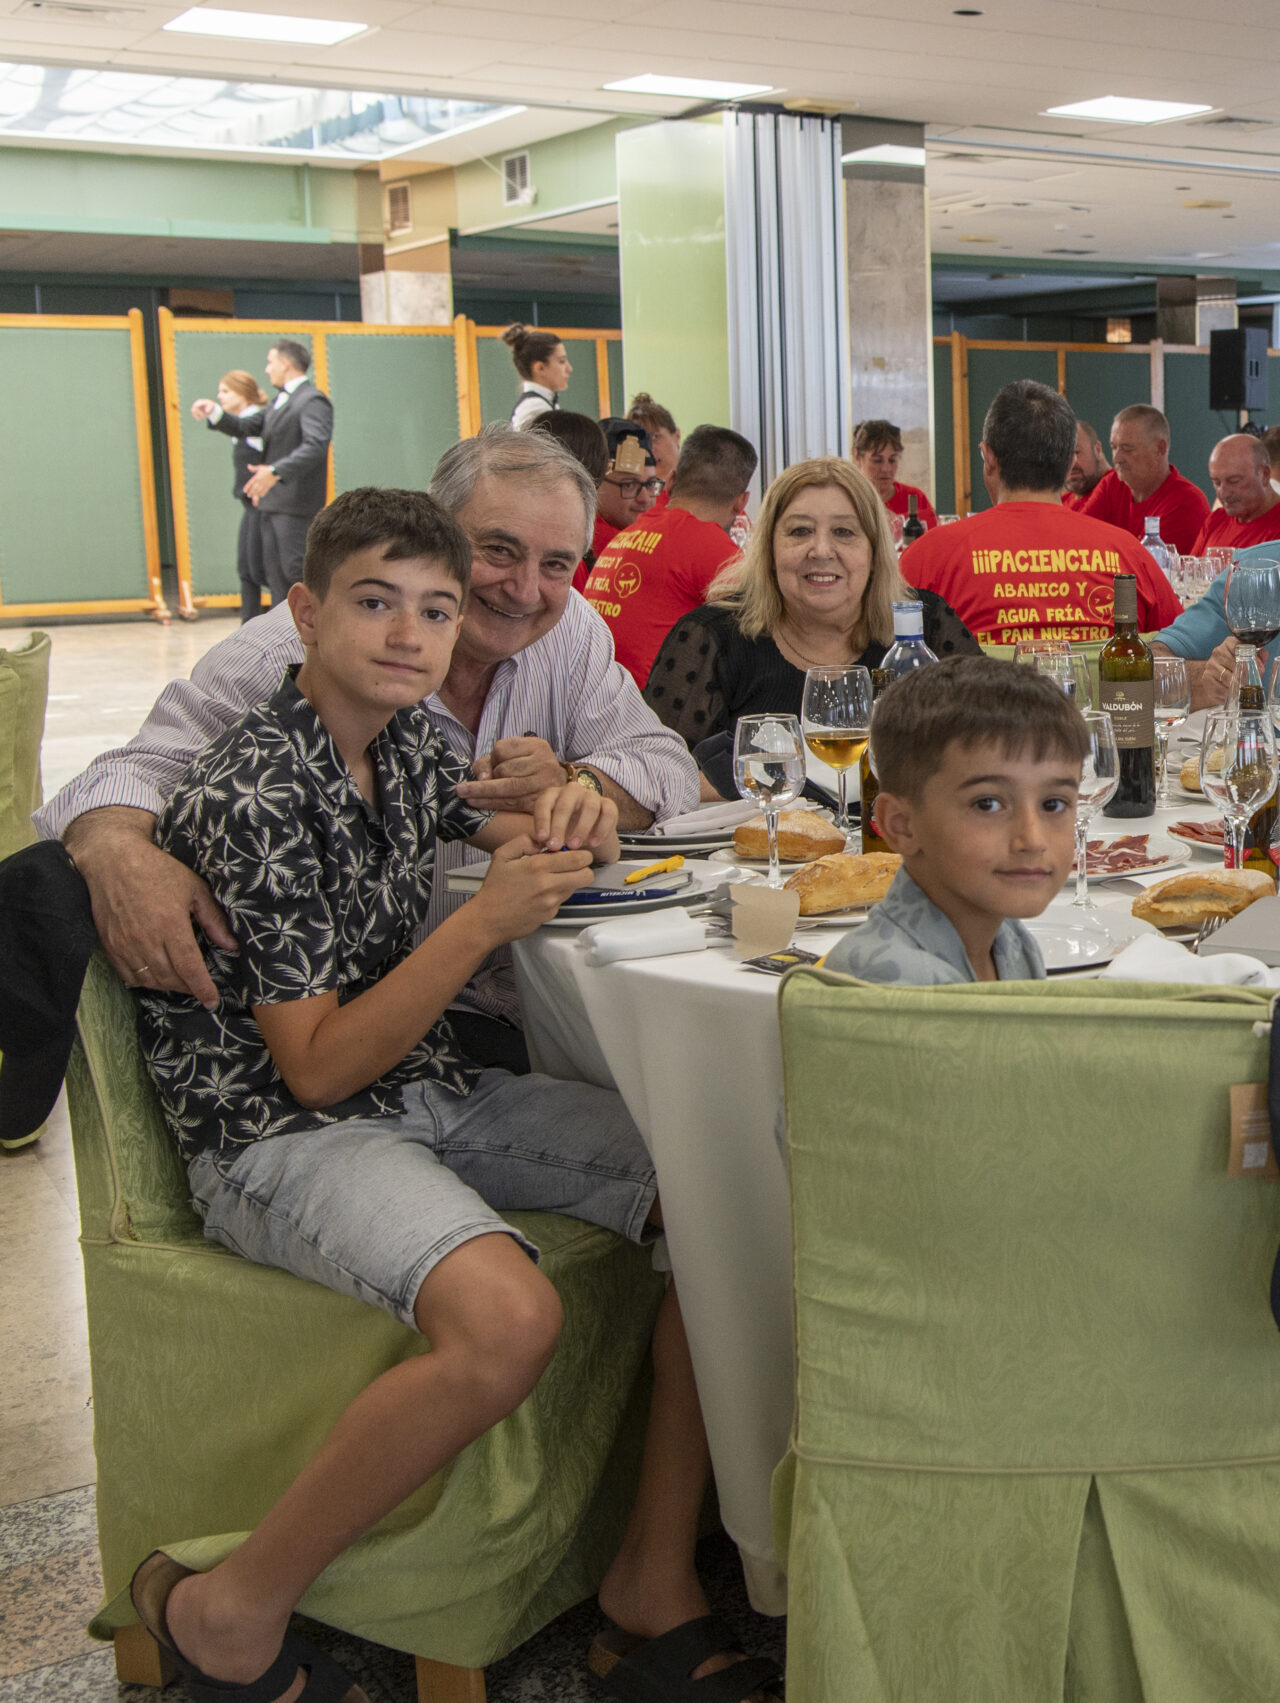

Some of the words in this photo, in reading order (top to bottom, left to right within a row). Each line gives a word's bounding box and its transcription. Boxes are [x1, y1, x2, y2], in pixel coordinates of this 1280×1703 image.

[972, 549, 1121, 574] ¡¡¡PACIENCIA!!!
[994, 583, 1070, 598] ABANICO
[1076, 582, 1088, 597] Y
[997, 608, 1040, 624] AGUA
[977, 632, 996, 645] EL
[1002, 627, 1034, 643] PAN
[1041, 626, 1109, 640] NUESTRO
[1102, 701, 1143, 711] VALDUBÓN
